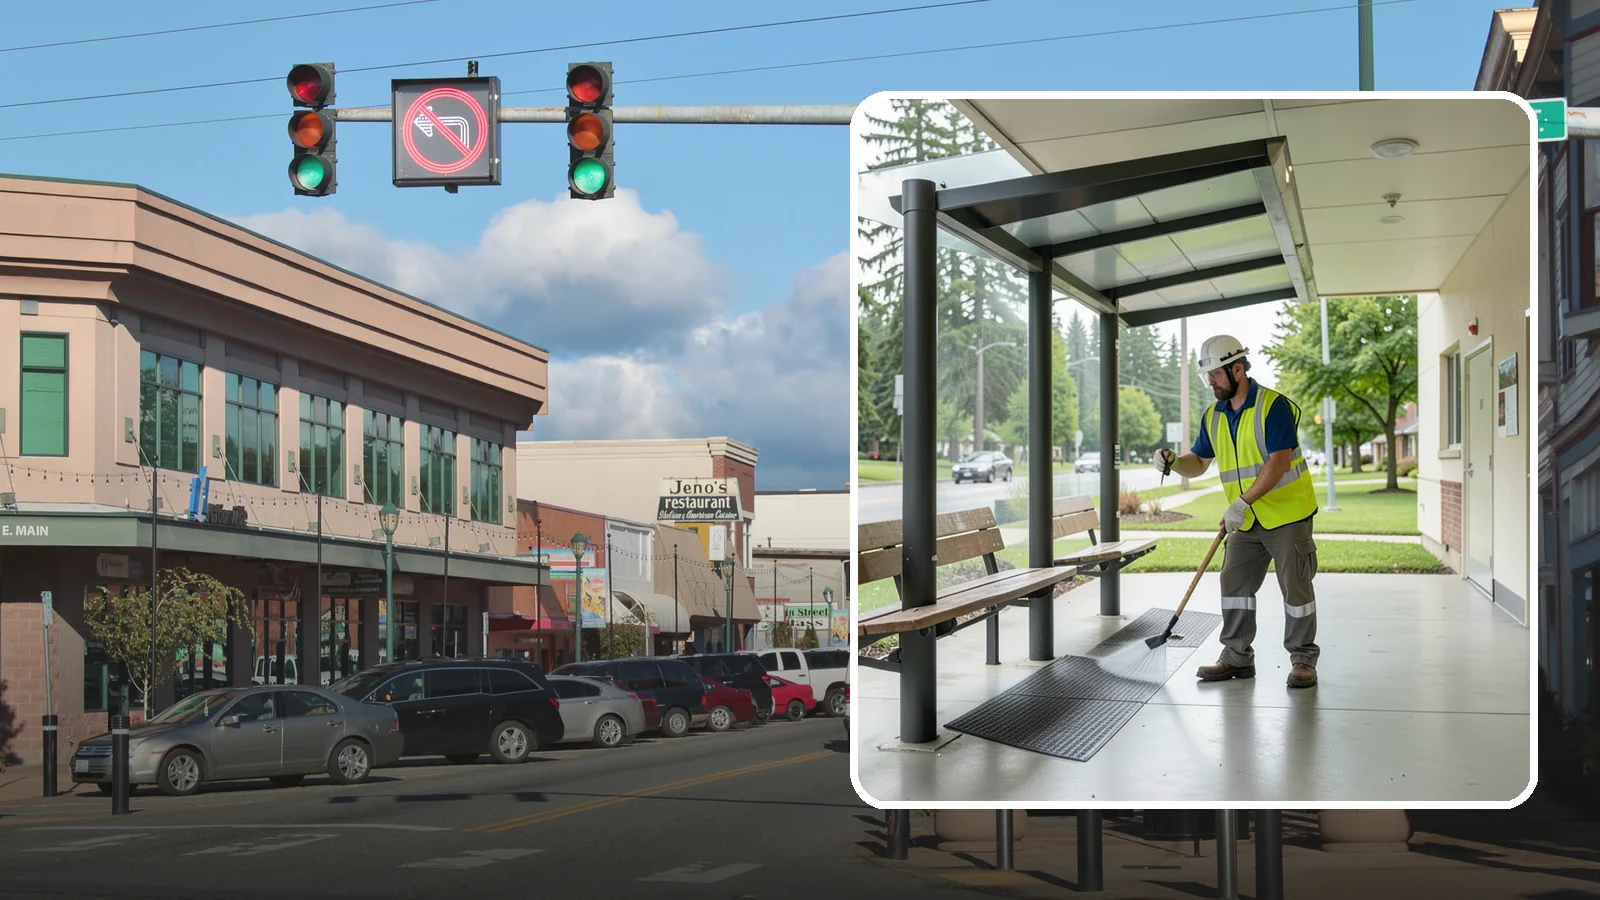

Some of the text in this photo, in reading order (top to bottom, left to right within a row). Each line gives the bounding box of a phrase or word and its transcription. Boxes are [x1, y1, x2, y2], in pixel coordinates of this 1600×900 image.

[670, 480, 727, 494] Jeno's
[665, 496, 731, 509] restaurant
[659, 510, 682, 519] Italian
[686, 510, 714, 519] American
[715, 509, 737, 519] Cuisine
[2, 525, 49, 536] E. MAIN
[797, 607, 829, 616] Street
